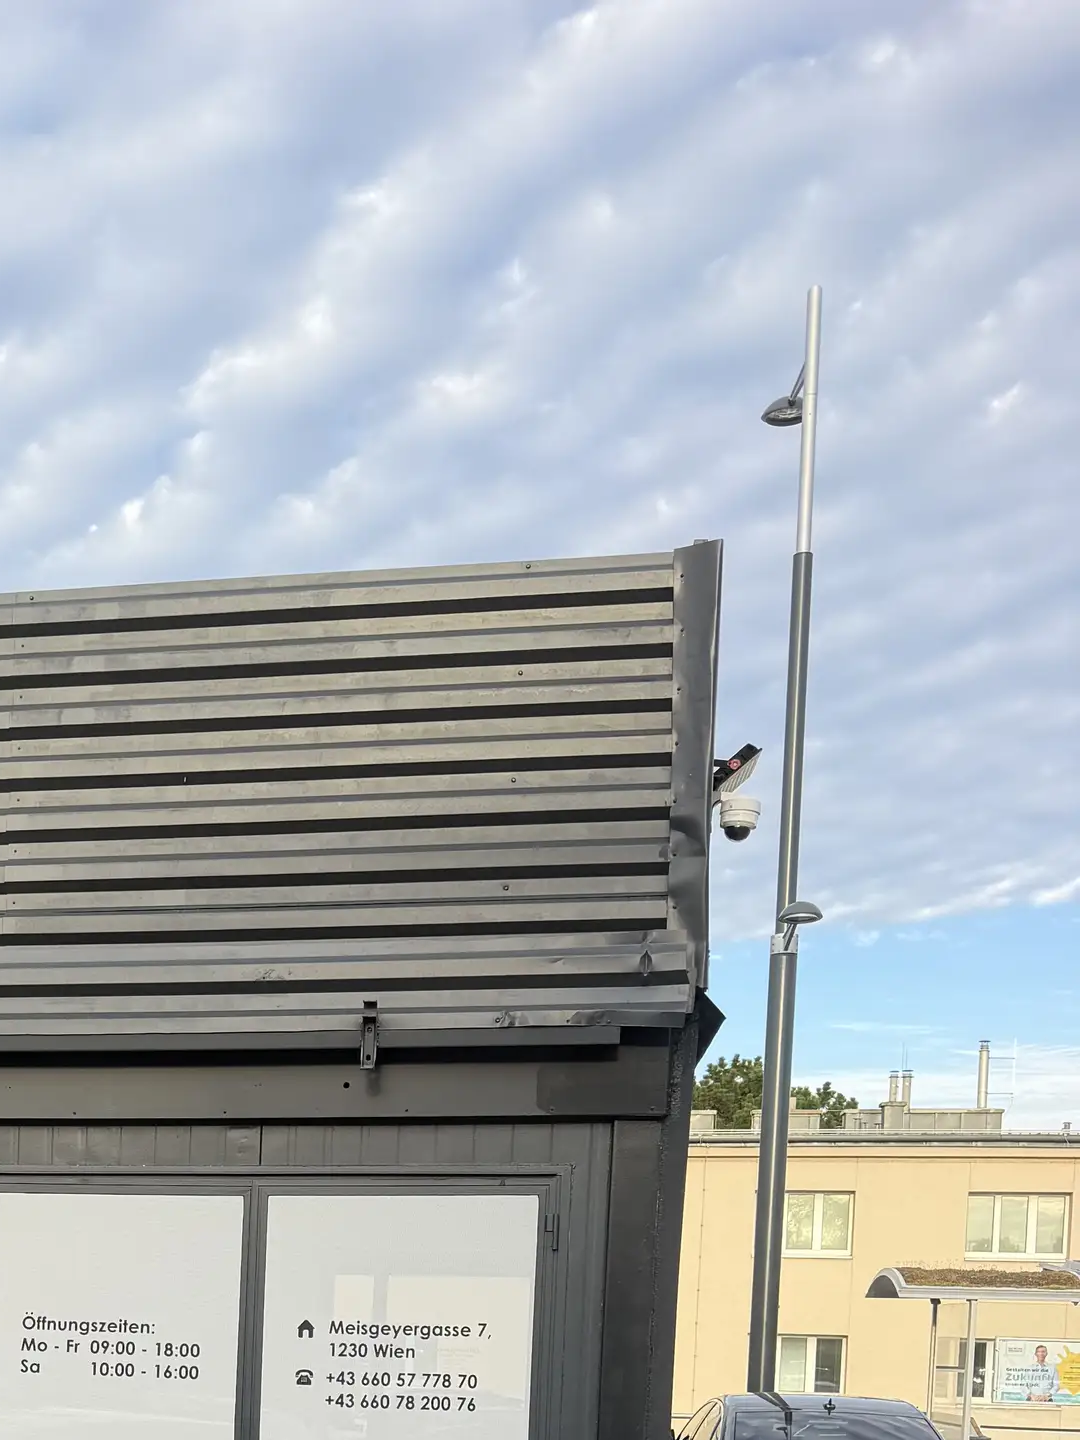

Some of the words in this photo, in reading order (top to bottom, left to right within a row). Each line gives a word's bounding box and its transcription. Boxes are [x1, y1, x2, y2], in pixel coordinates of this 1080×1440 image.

[21, 1311, 156, 1335] Öffnungszeiten:
[329, 1320, 471, 1340] Meisgeyergasse
[477, 1322, 492, 1340] 7,
[20, 1337, 48, 1352] Mo
[66, 1339, 80, 1353] Fr
[90, 1340, 136, 1356] 09:00
[155, 1342, 201, 1358] 18:00
[329, 1342, 368, 1358] 1230
[373, 1343, 416, 1359] Wien
[20, 1358, 40, 1374] Sa
[91, 1361, 135, 1377] 10:00
[155, 1364, 200, 1380] 16:00
[325, 1370, 356, 1386] +43
[361, 1371, 391, 1387] 660
[396, 1372, 416, 1387] 57
[421, 1373, 452, 1388] 778
[458, 1374, 478, 1389] 70
[325, 1393, 355, 1409] +43
[360, 1394, 390, 1409] 660
[395, 1395, 415, 1410] 78
[420, 1396, 451, 1411] 200
[457, 1397, 476, 1412] 76
